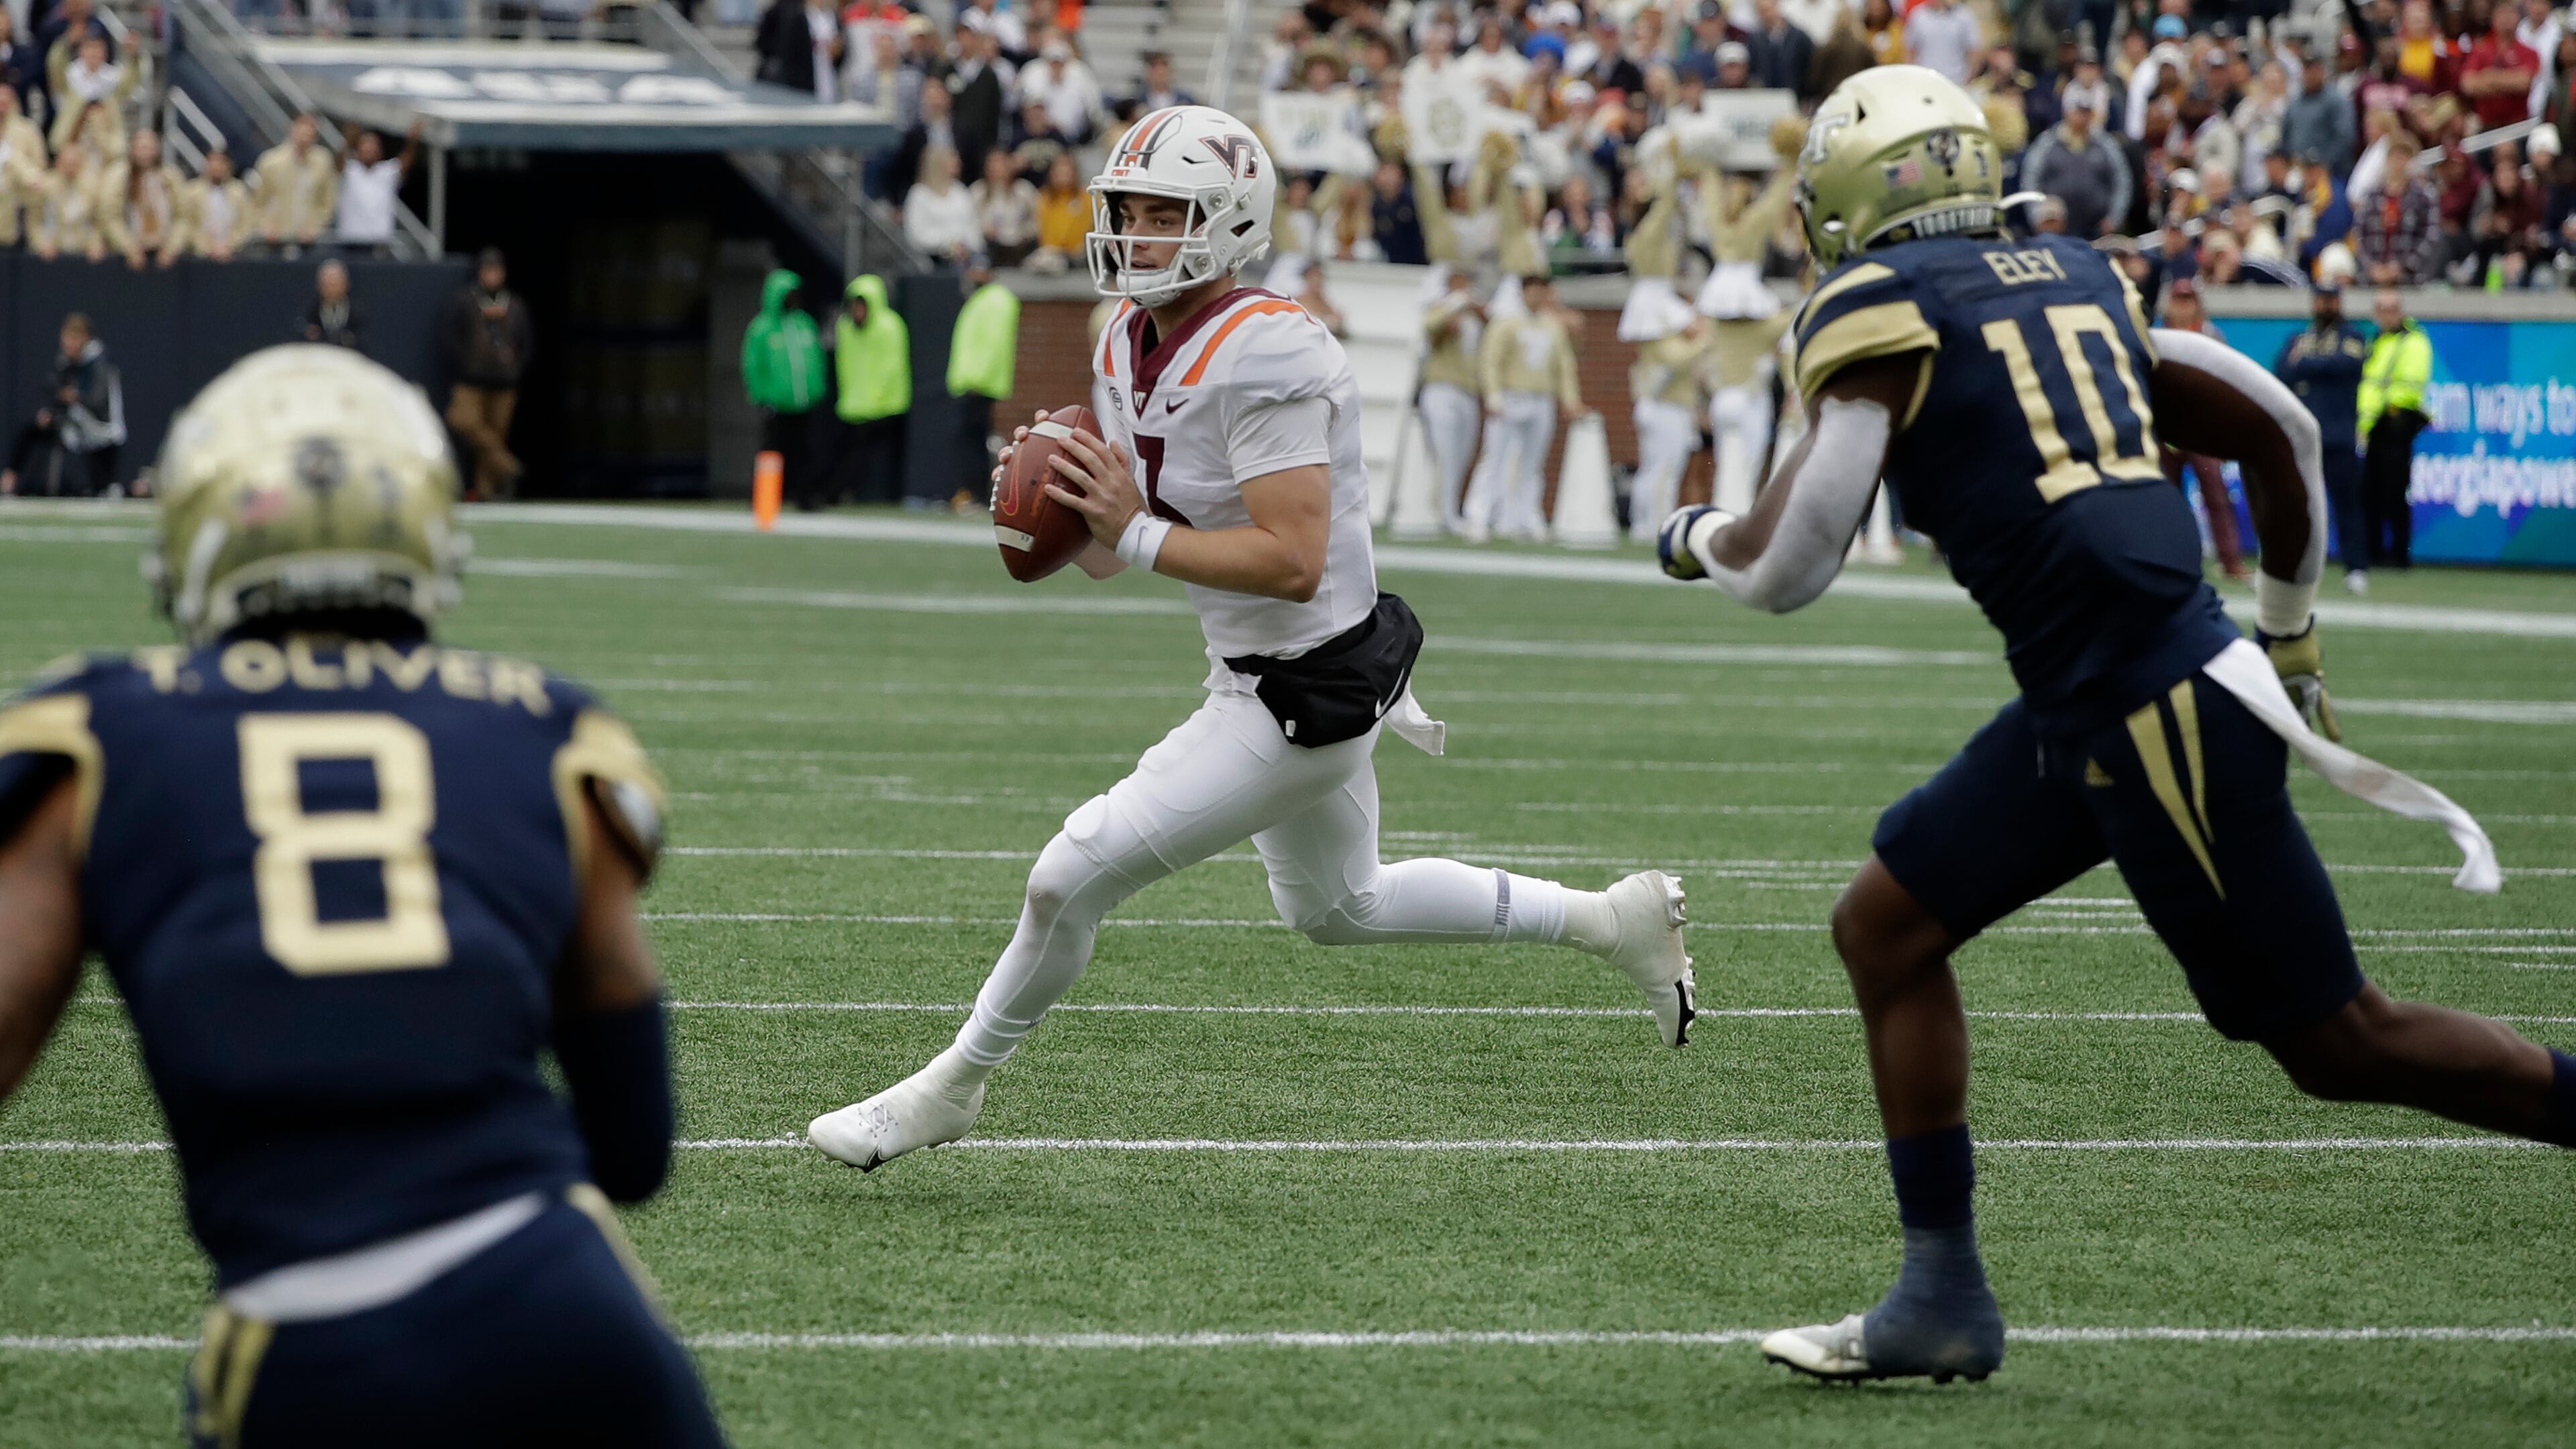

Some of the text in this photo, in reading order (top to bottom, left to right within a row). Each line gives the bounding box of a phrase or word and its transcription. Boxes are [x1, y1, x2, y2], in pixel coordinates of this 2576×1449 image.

[1980, 303, 2165, 504] 10
[2472, 380, 2544, 449] ways
[2546, 376, 2576, 435] to
[2405, 437, 2576, 520] eorgiapowe
[220, 639, 551, 716] OLIVER
[236, 711, 451, 977] 8
